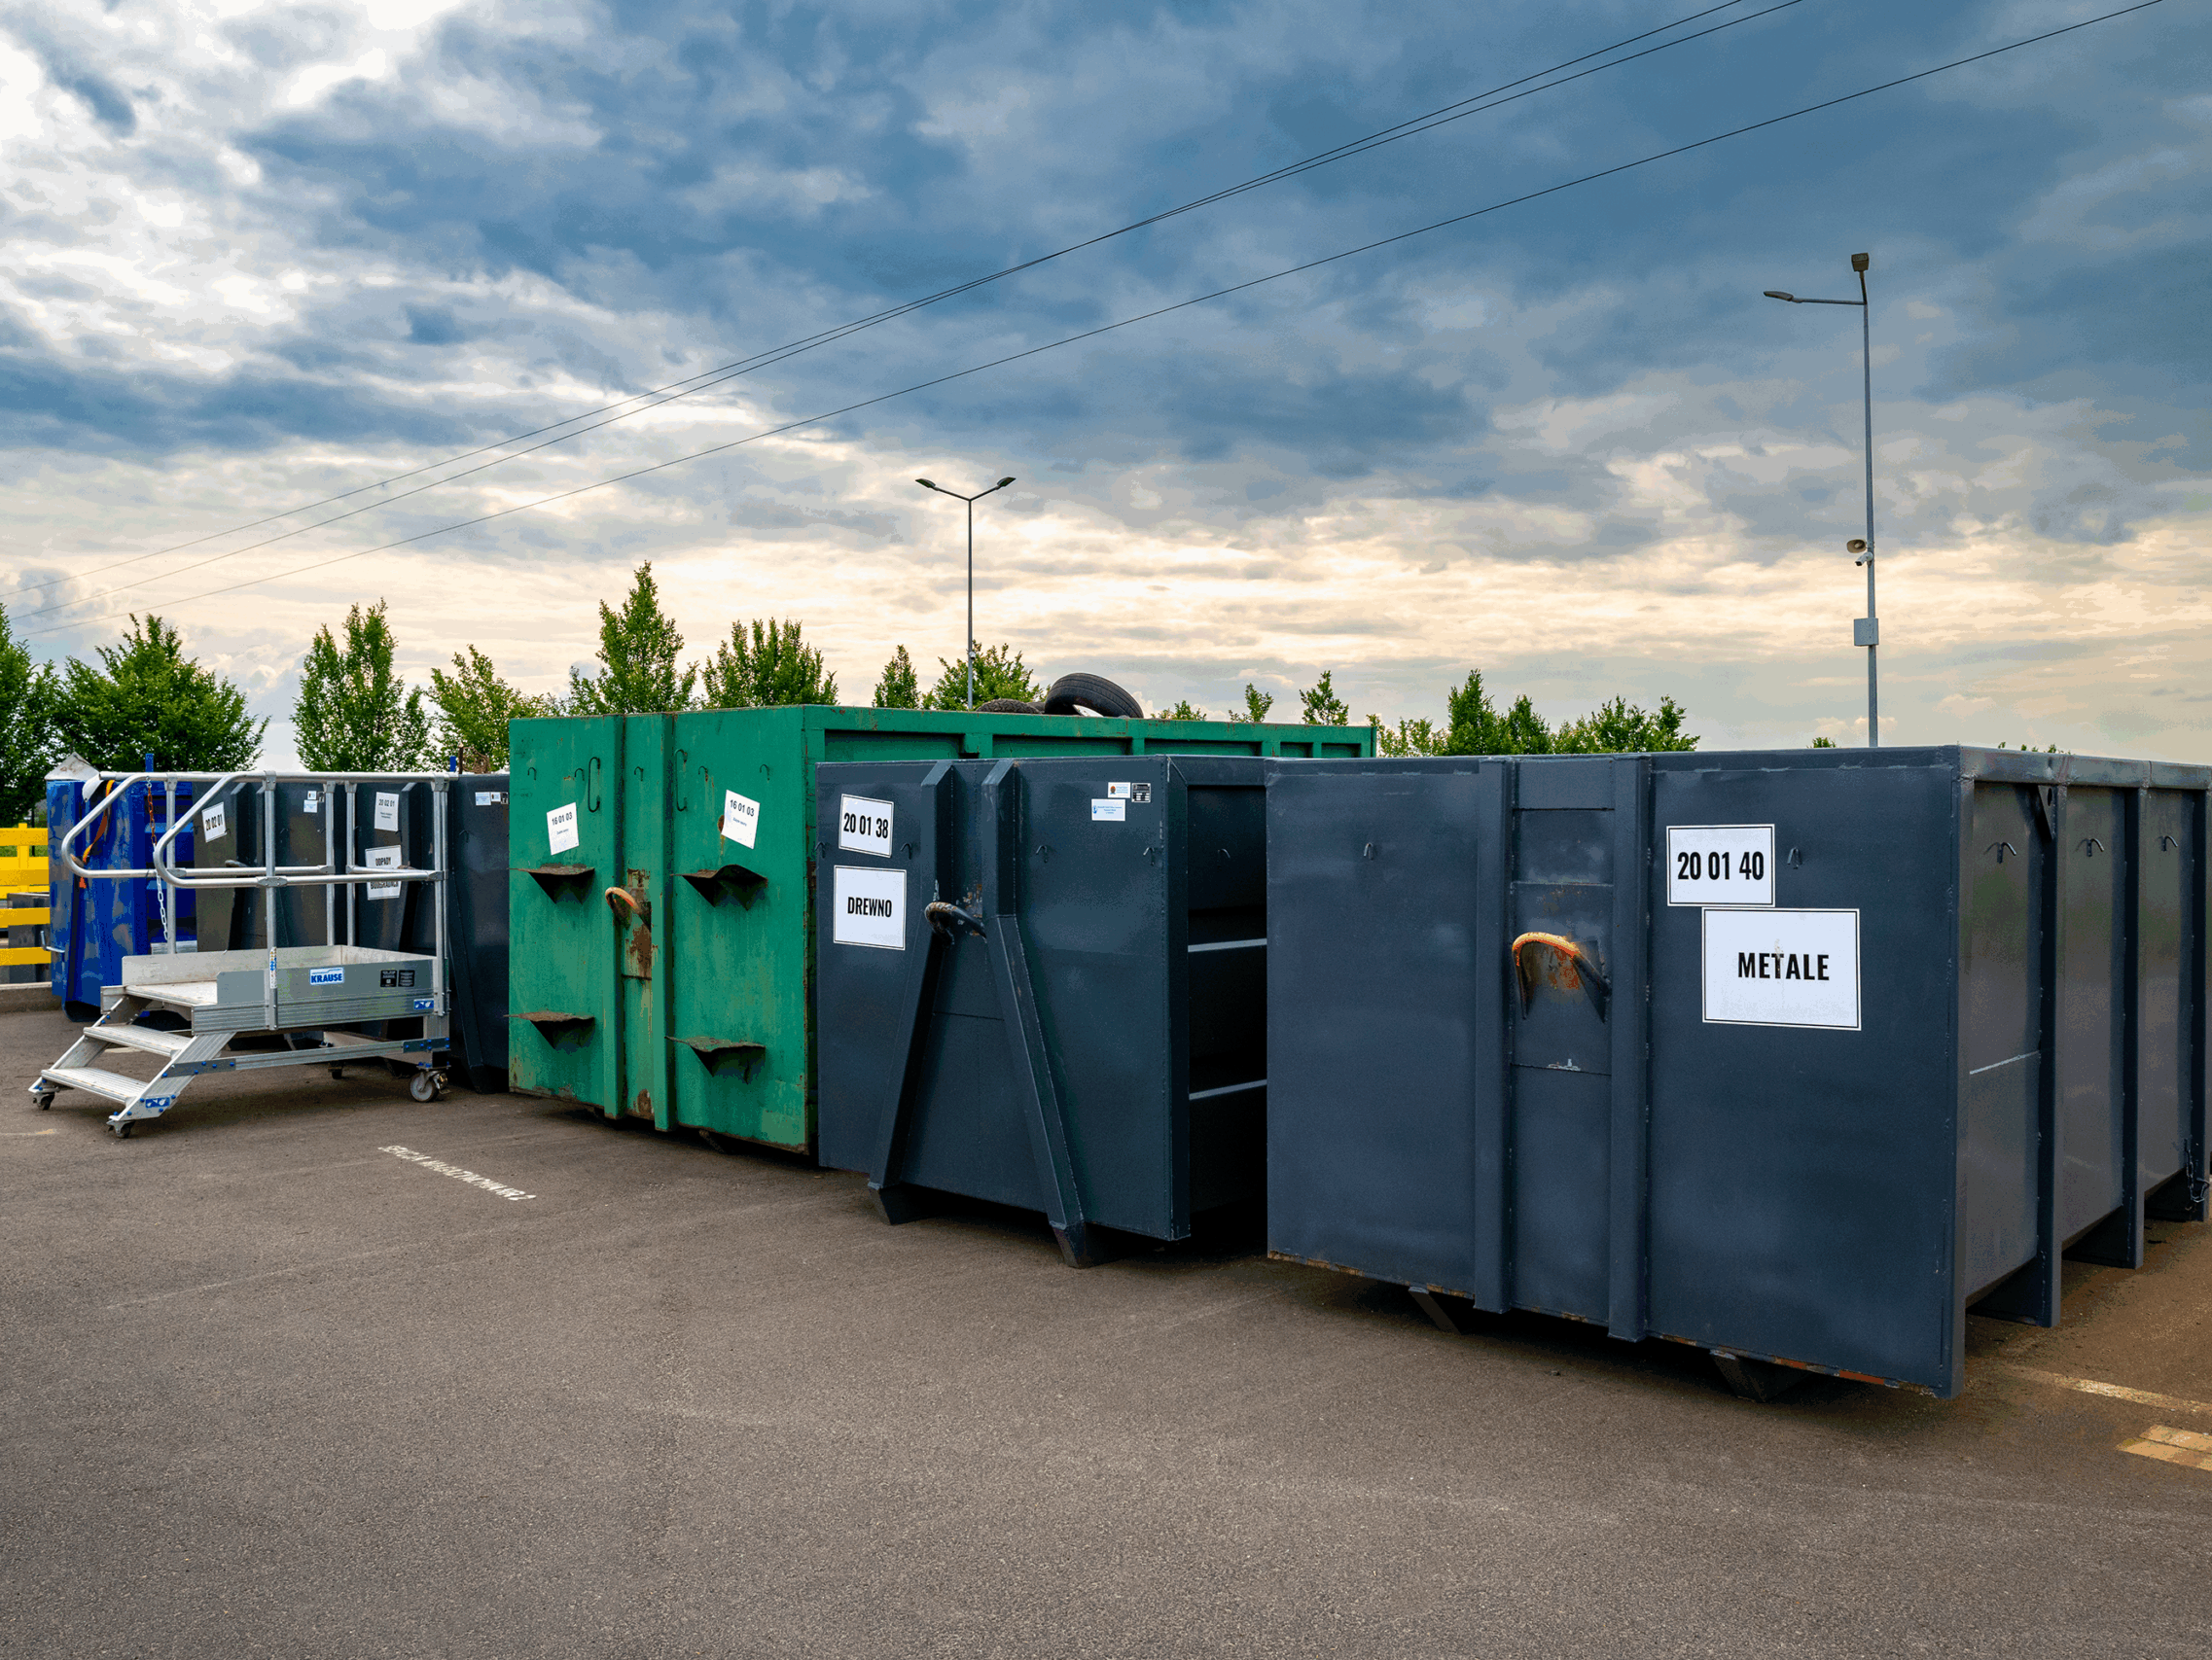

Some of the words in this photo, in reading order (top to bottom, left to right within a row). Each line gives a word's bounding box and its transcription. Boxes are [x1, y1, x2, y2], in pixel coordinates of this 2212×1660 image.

[730, 799, 737, 810] 16
[737, 802, 745, 813] 01
[746, 806, 755, 817] 03
[205, 818, 211, 830] 20
[211, 816, 217, 829] 02
[217, 814, 223, 826] 01
[552, 817, 558, 826] 16
[558, 814, 565, 824] 01
[565, 811, 573, 821] 03
[843, 812, 856, 833] 20
[859, 815, 872, 835] 01
[875, 817, 889, 839] 38
[1677, 851, 1701, 880] 20
[1708, 851, 1730, 880] 01
[1738, 851, 1765, 880] 40
[847, 896, 892, 918] DREWNO
[1737, 952, 1830, 981] METALE
[311, 973, 342, 983] KRAUSE
